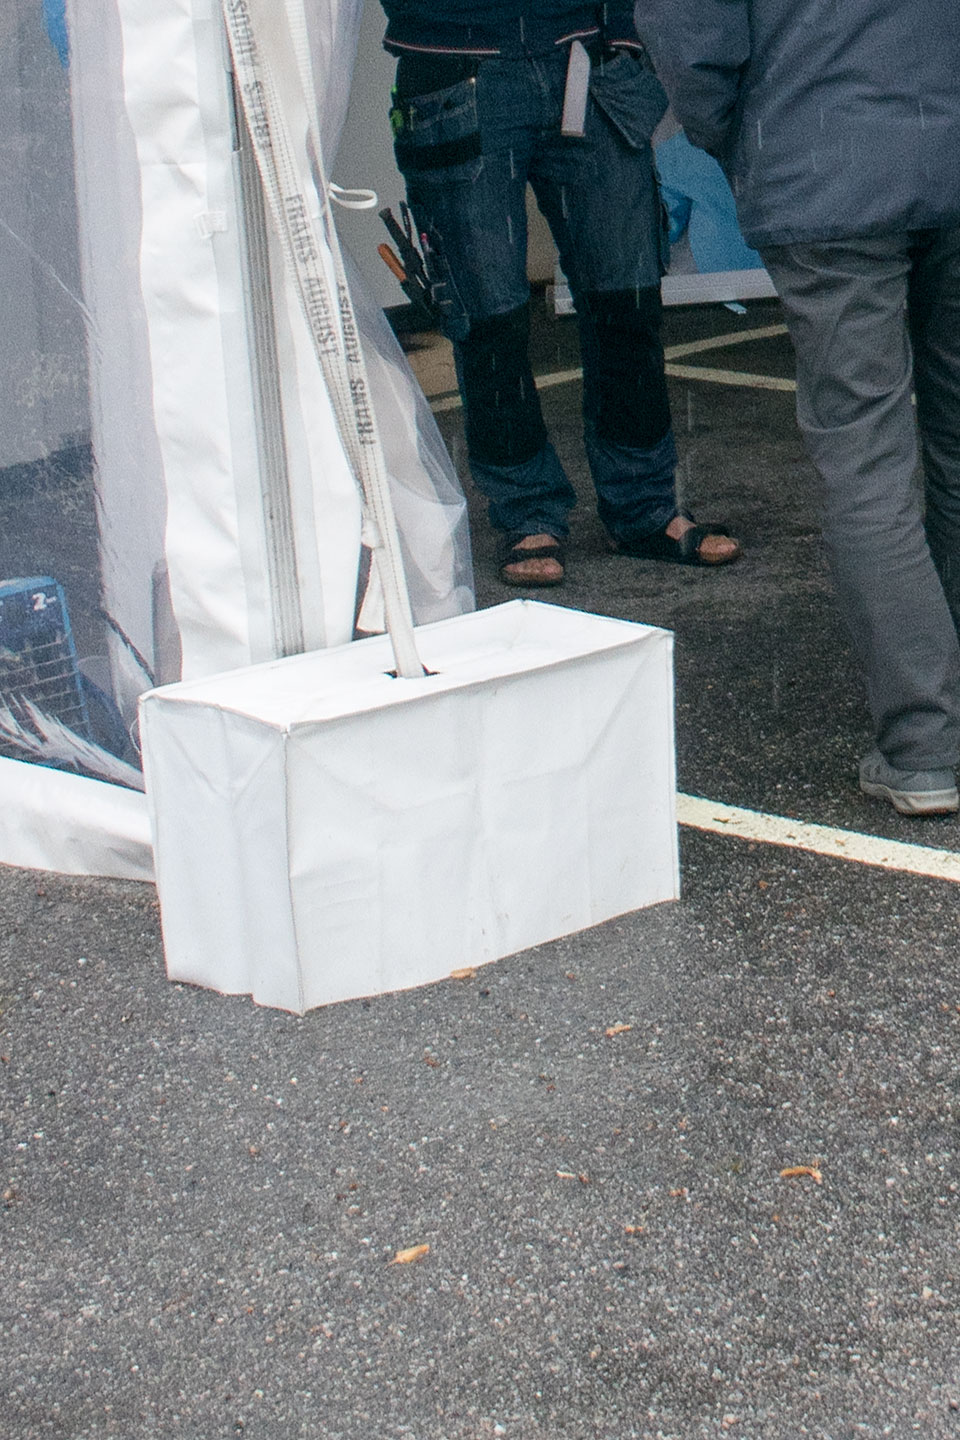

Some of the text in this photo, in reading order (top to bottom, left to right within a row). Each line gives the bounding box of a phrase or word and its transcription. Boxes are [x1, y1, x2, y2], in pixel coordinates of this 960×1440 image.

[286, 193, 340, 357] FRANS AUGUST
[350, 377, 377, 446] FRANS
